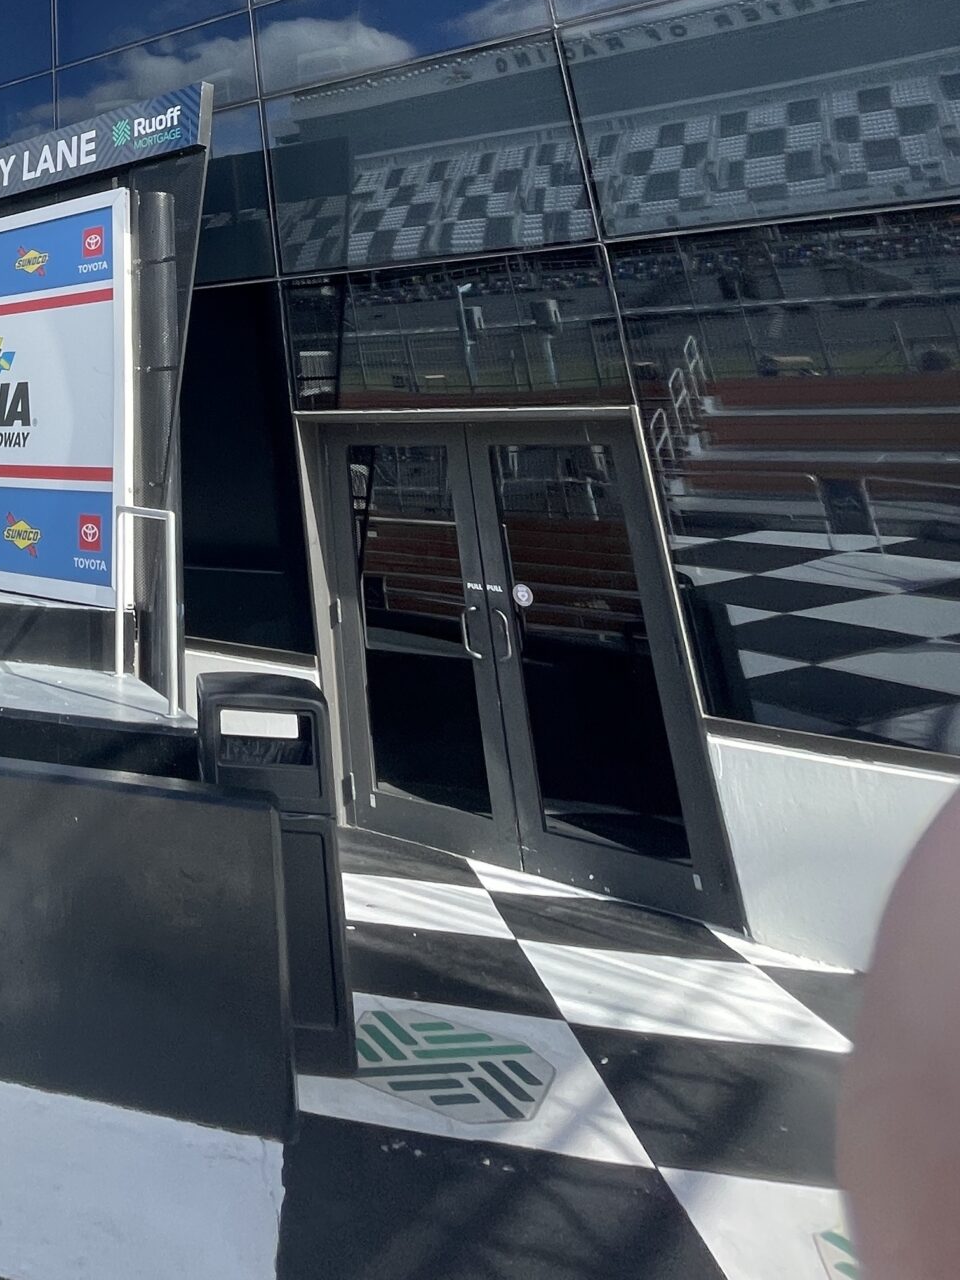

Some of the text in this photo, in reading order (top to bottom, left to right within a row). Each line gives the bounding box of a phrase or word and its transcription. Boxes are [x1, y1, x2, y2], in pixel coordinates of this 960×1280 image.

[133, 105, 181, 137] Ruoff
[133, 127, 181, 150] MORTGAGE
[22, 130, 97, 178] LANE
[17, 253, 48, 268] SUNOCO
[78, 260, 108, 274] TOYOTA
[5, 527, 39, 543] SUNOCO
[73, 556, 107, 572] TOYOTA
[467, 582, 483, 591] PULL
[486, 584, 503, 593] PULL
